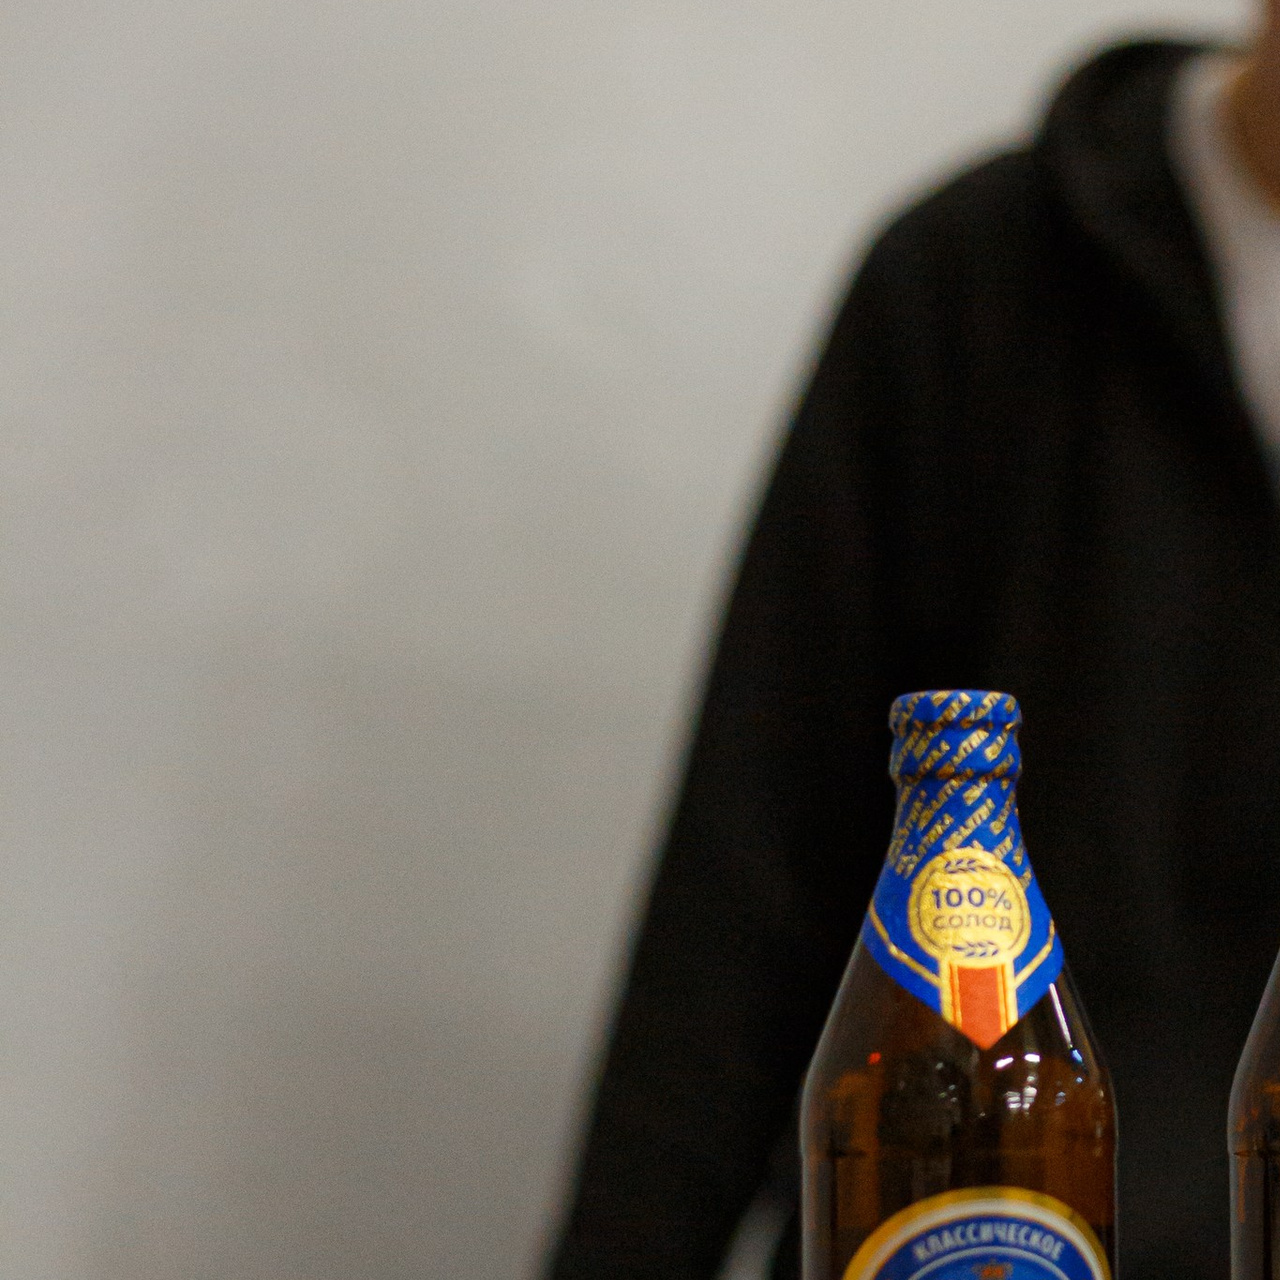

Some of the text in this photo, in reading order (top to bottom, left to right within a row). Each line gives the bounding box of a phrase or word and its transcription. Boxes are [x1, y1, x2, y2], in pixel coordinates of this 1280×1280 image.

[932, 887, 1012, 911] 100%
[933, 913, 1014, 932] СОЛОД
[913, 1222, 1065, 1262] КЛАССИЧЕСКОЕ
